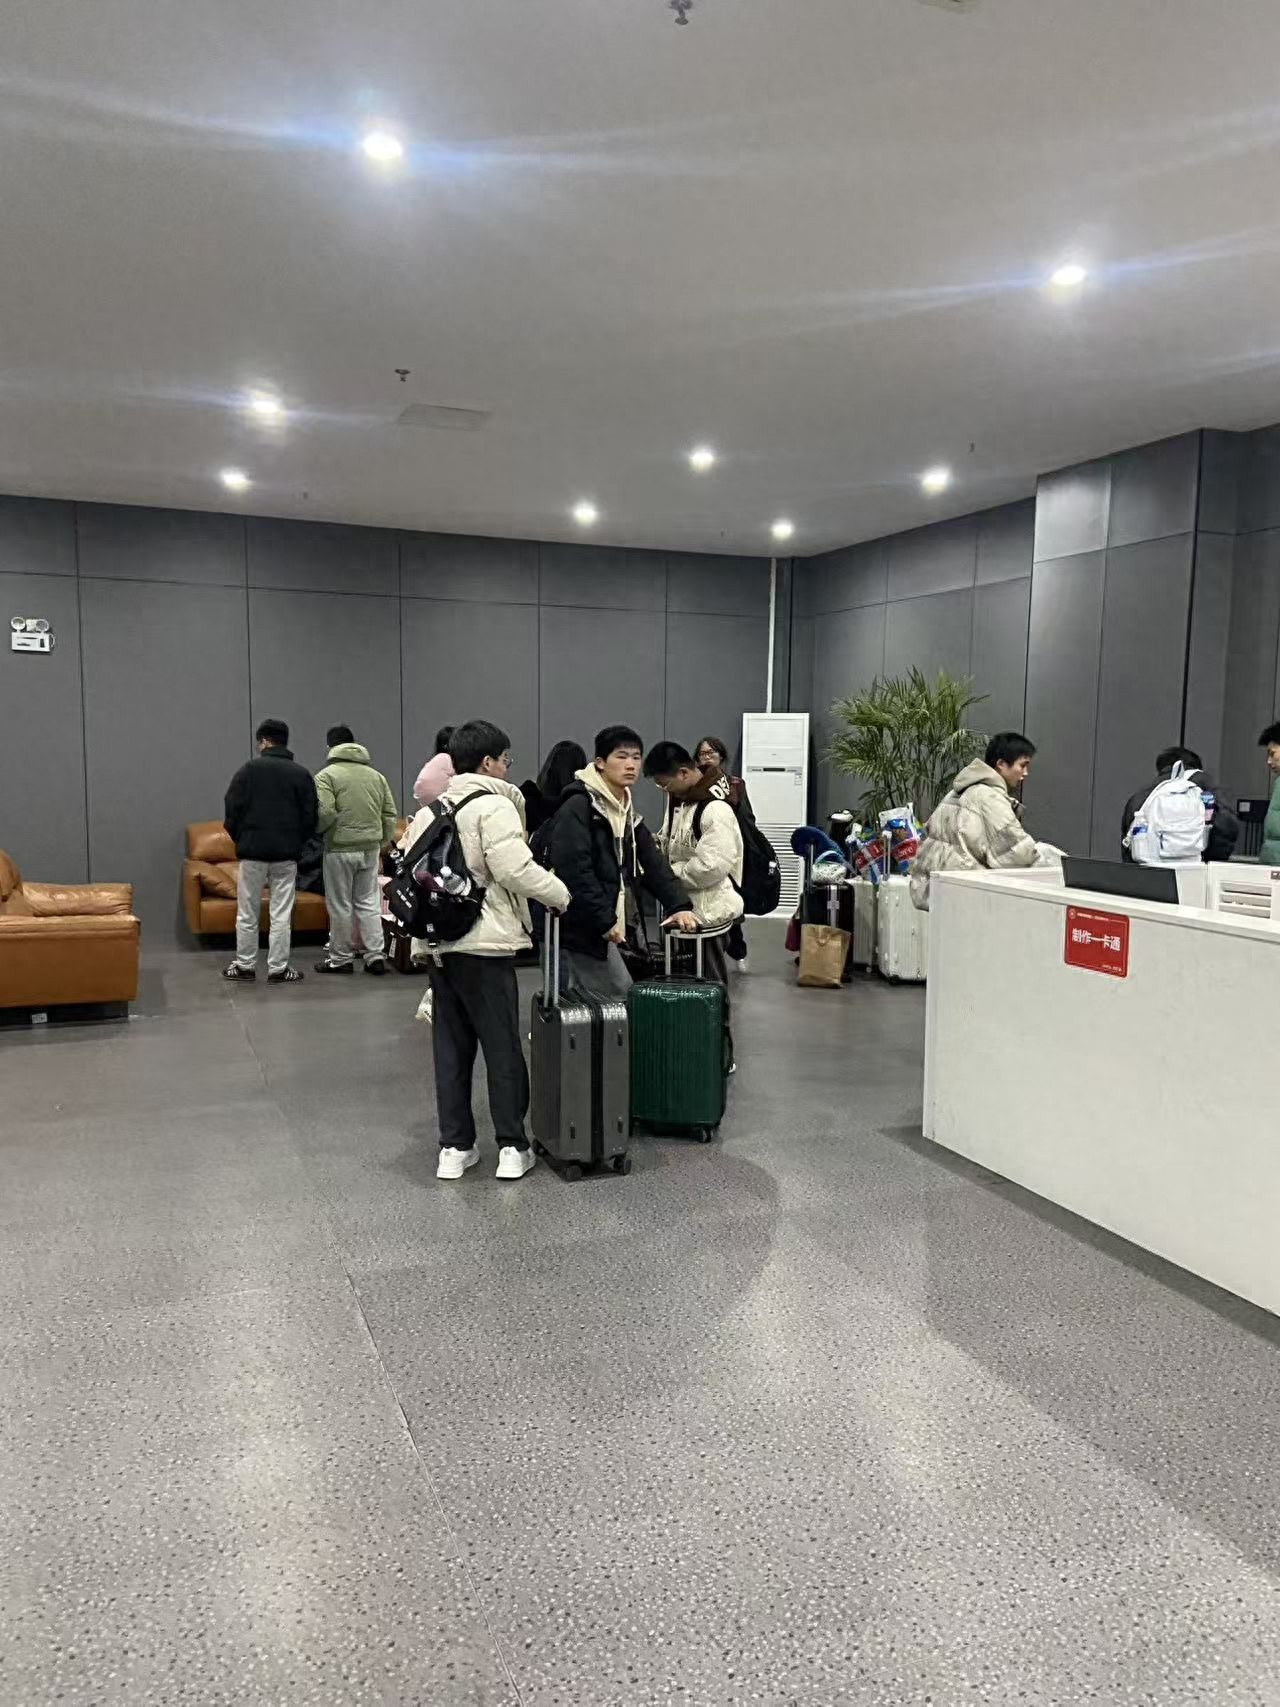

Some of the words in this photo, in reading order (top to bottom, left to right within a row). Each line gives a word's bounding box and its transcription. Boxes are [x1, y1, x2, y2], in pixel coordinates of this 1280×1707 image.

[1072, 928, 1121, 952] 制作一卡通
